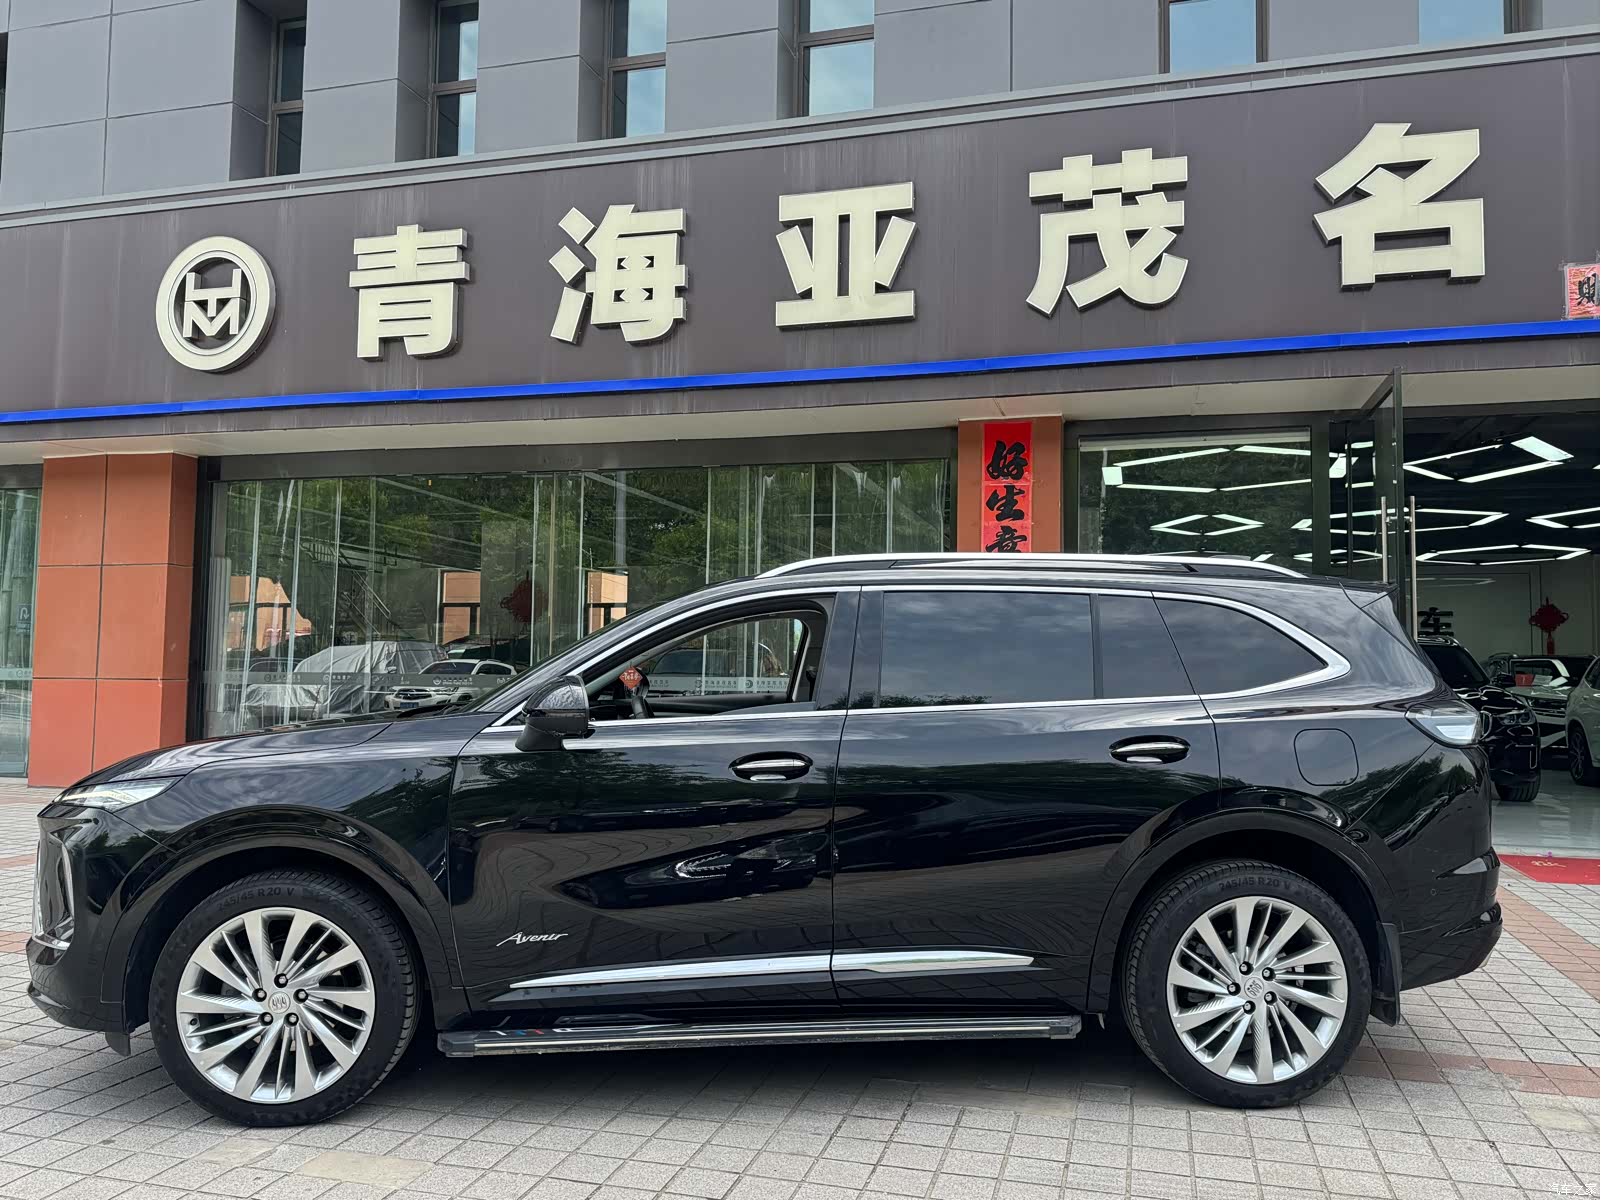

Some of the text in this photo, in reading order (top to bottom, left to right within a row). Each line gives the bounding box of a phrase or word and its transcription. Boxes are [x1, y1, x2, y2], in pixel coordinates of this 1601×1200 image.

[349, 123, 1486, 359] 青海亚茂名
[257, 886, 281, 897] R20
[286, 887, 295, 897] V
[496, 931, 569, 947] Avenir
